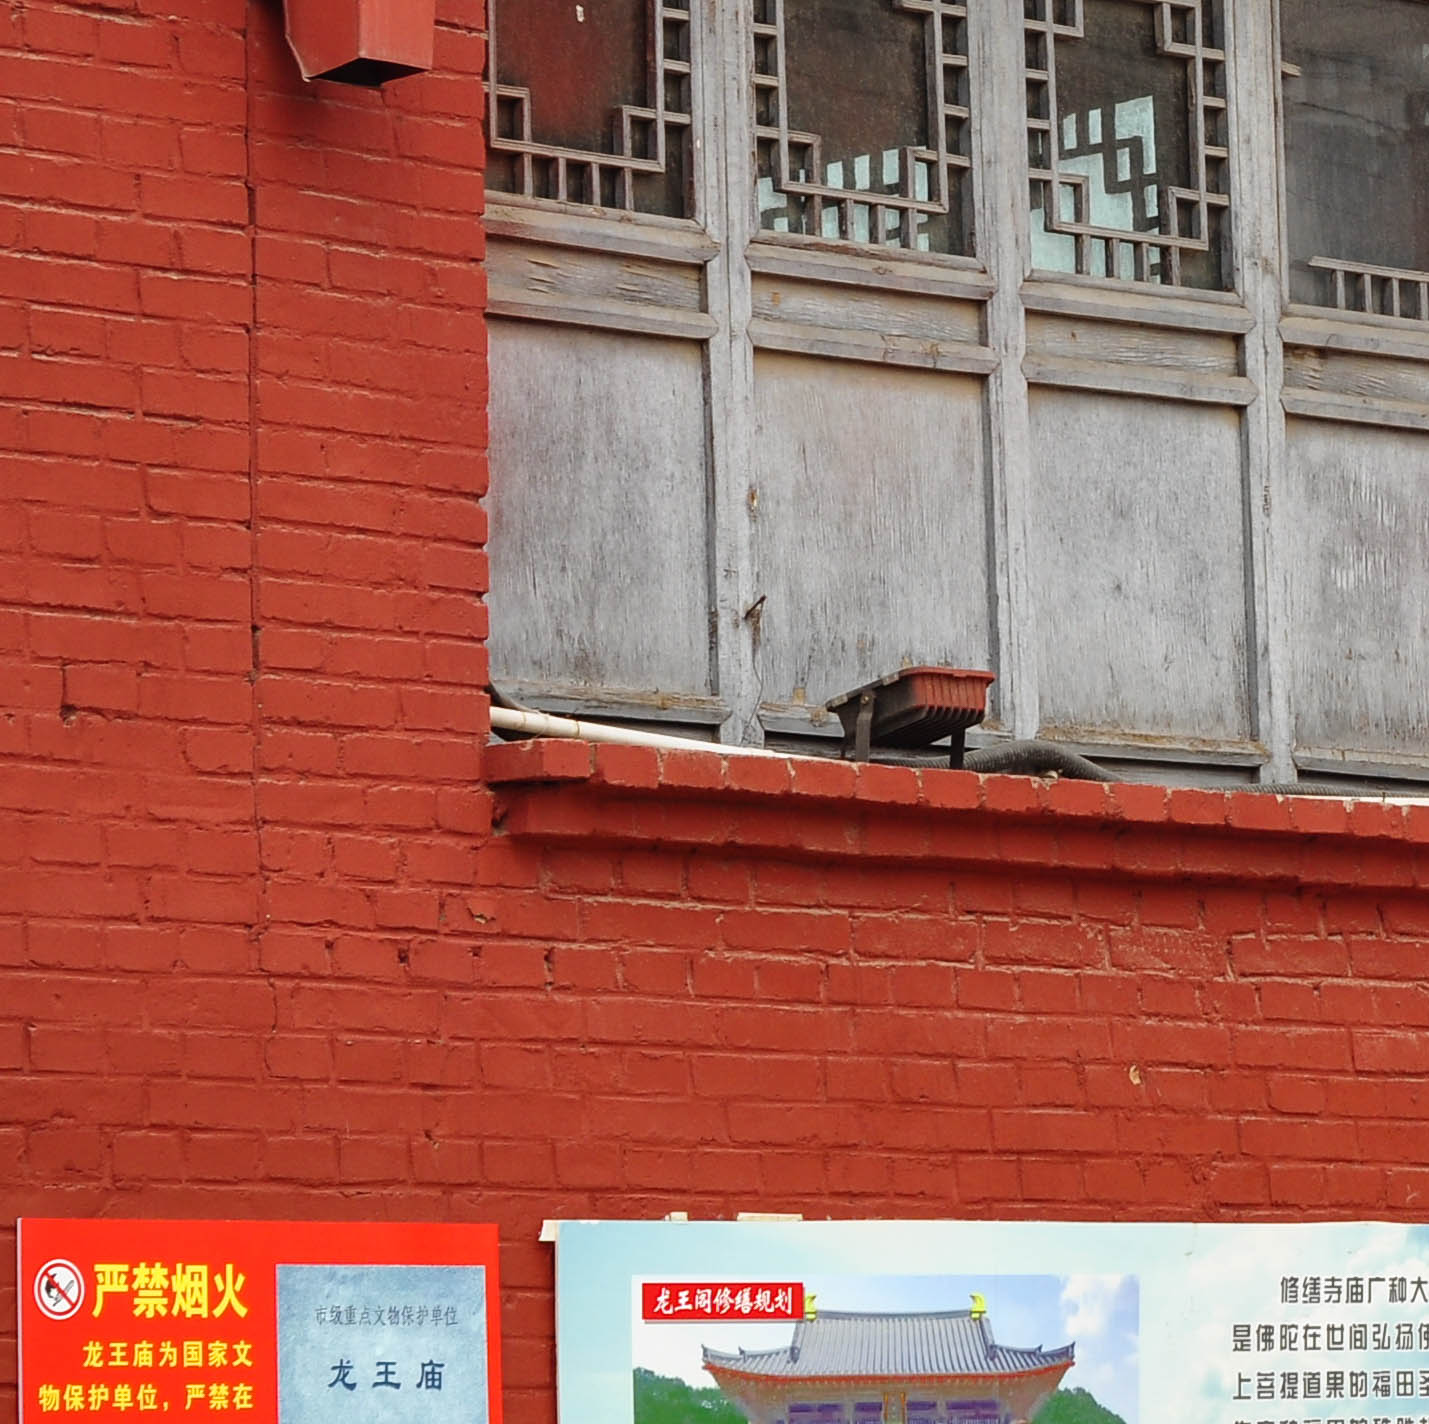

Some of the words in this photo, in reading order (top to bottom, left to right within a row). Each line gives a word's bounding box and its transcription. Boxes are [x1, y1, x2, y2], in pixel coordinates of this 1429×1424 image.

[92, 1262, 248, 1320] 严禁烟火
[652, 1285, 794, 1315] 龙王阁修缮规划
[314, 1304, 459, 1327] 市级重点文物保护单位
[83, 1340, 254, 1368] 龙王庙为国家文
[328, 1358, 446, 1392] 龙王庙
[38, 1383, 254, 1412] 物保护单位，严禁在
